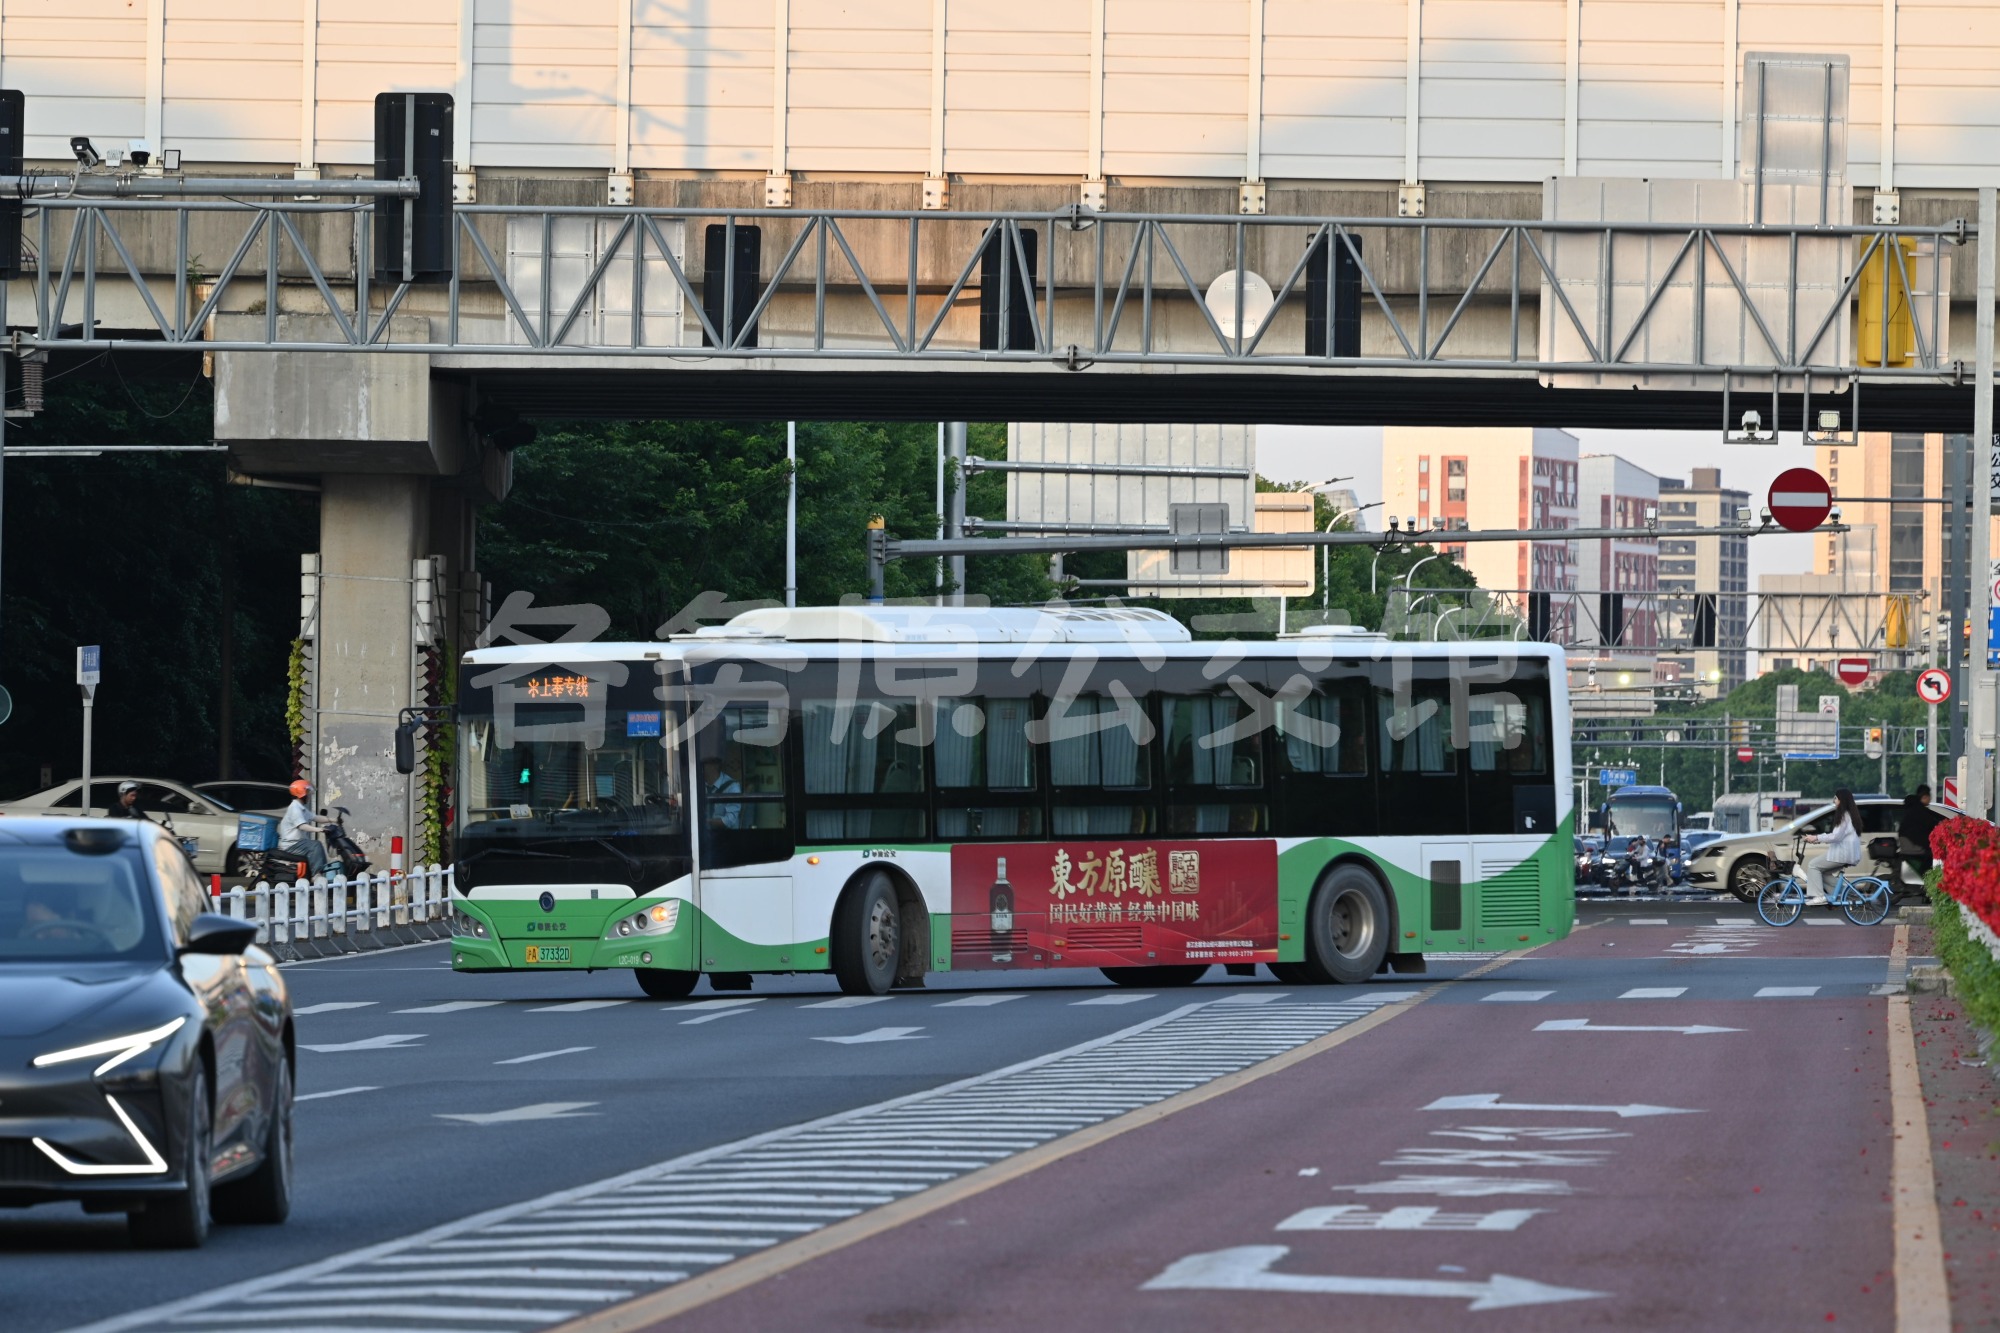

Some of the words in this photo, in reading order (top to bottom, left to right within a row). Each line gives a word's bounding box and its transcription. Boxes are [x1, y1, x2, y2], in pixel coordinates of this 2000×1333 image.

[1049, 903, 1122, 924] 国民好黄酒
[1128, 900, 1200, 923] 经典中国味
